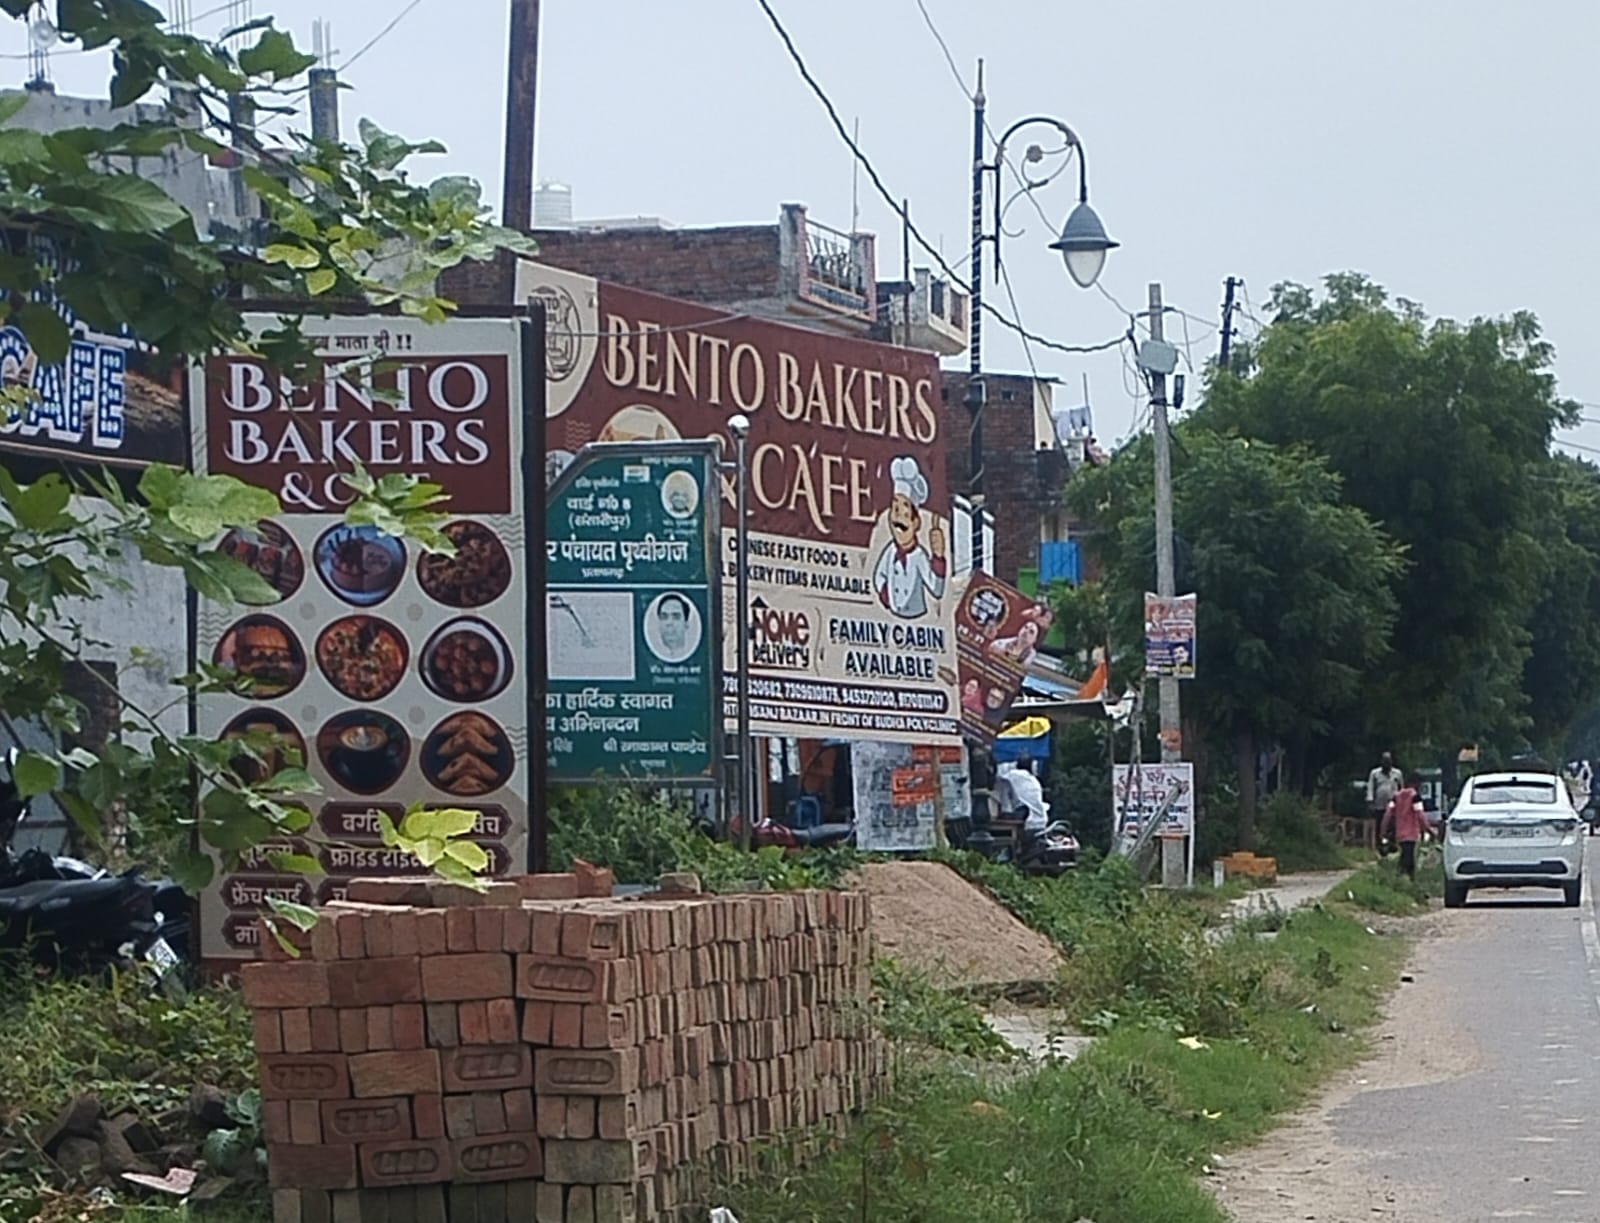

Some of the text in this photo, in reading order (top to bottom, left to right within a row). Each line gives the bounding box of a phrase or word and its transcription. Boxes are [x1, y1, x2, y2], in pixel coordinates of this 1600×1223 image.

[335, 334, 369, 350] माता
[222, 360, 489, 413] BENTO
[602, 314, 938, 444] BENTO BAKERS
[223, 418, 489, 465] BAKERS
[280, 472, 326, 511] &
[560, 533, 616, 562] पंचायत
[778, 543, 805, 563] FAST
[807, 548, 839, 567] FOOD
[774, 568, 808, 587] ITEMS
[810, 572, 871, 595] AVAILABLE
[829, 618, 889, 644] FAMILY
[892, 626, 945, 650] CABIN
[845, 651, 934, 678] AVAILABLE
[565, 688, 616, 710] हार्दिक
[619, 693, 674, 710] स्वागत
[559, 711, 640, 732] अभिनन्दन
